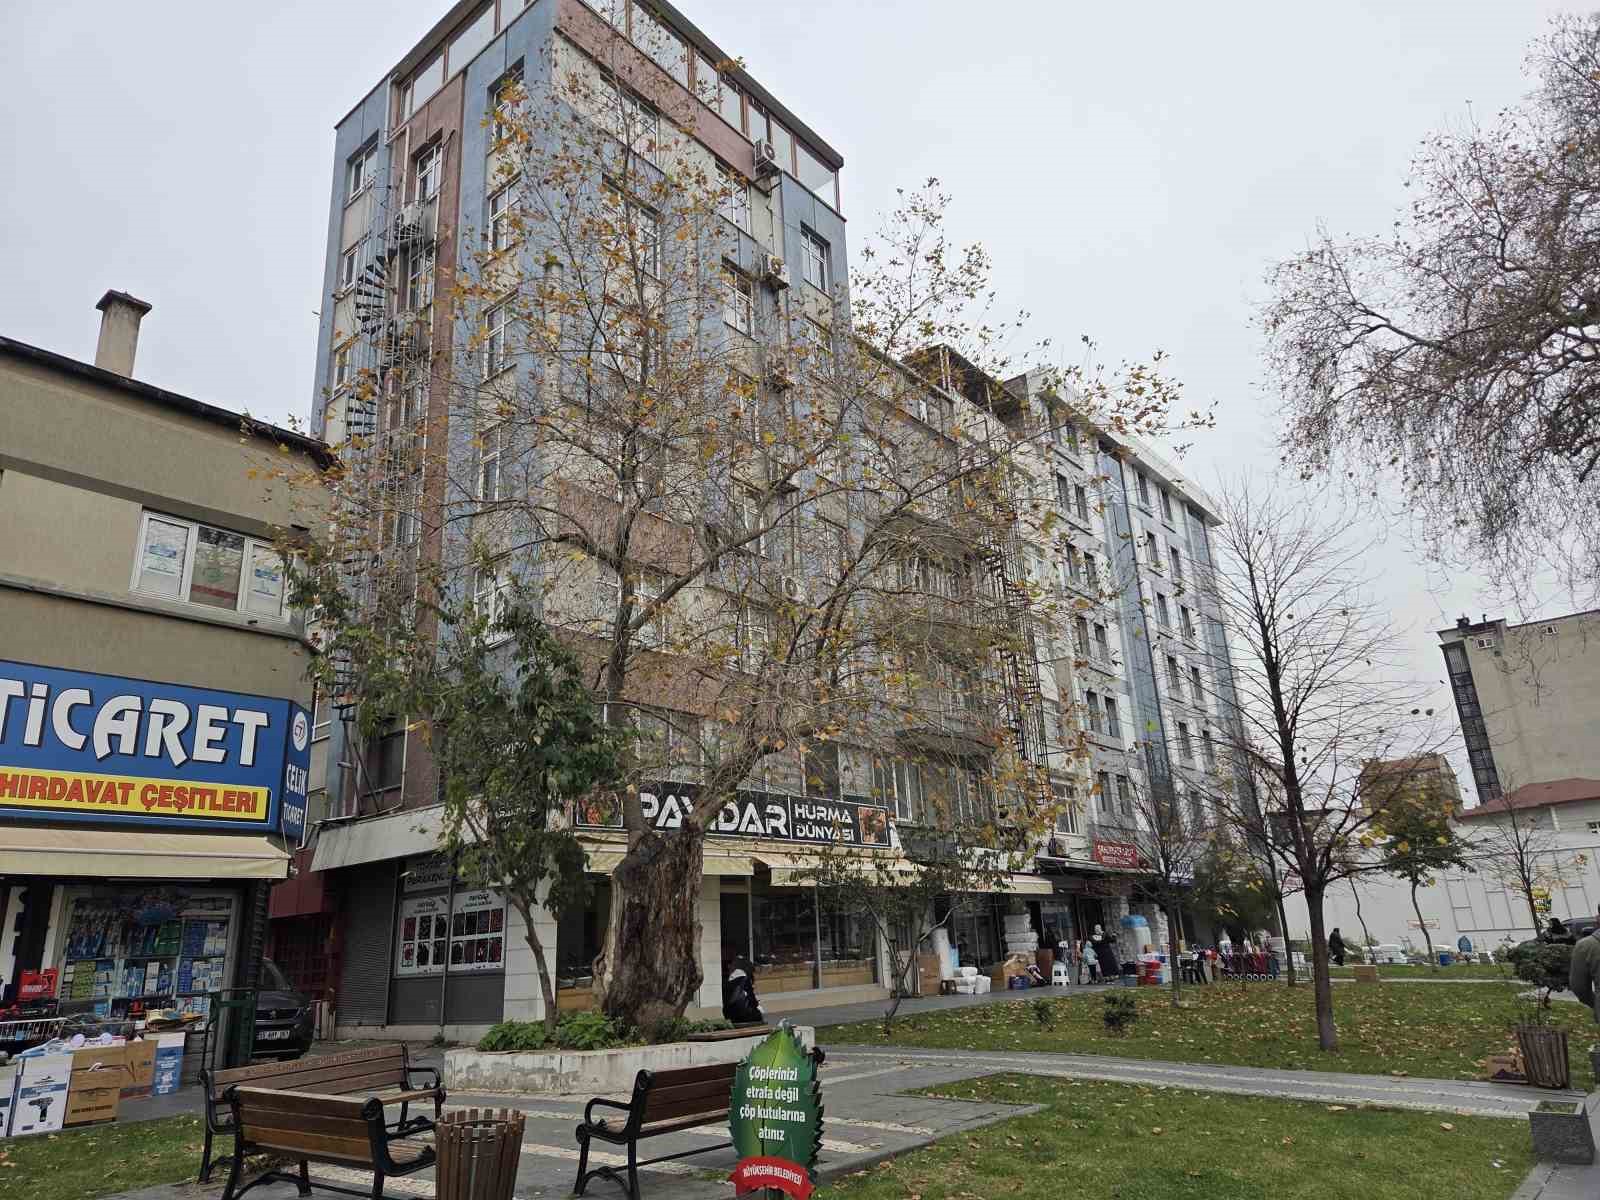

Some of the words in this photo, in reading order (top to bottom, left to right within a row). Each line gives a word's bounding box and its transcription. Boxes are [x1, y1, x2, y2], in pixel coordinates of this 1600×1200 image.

[0, 678, 268, 767] TİCARET
[0, 774, 134, 805] HIRDAVAT
[286, 763, 307, 796] ÇELİK
[639, 792, 788, 836] PADAR
[794, 803, 852, 824] HURMA
[795, 823, 854, 842] DÜNYASI
[748, 1066, 798, 1081] Çöplerinizi
[746, 1086, 773, 1099] etrafa
[774, 1087, 799, 1103] değil
[739, 1104, 756, 1120] çöp
[757, 1105, 806, 1122] kutularına
[758, 1126, 785, 1141] atınız
[743, 1164, 773, 1178] BÜYÜKŞEHİR
[773, 1166, 803, 1185] BELEDİYESİ
